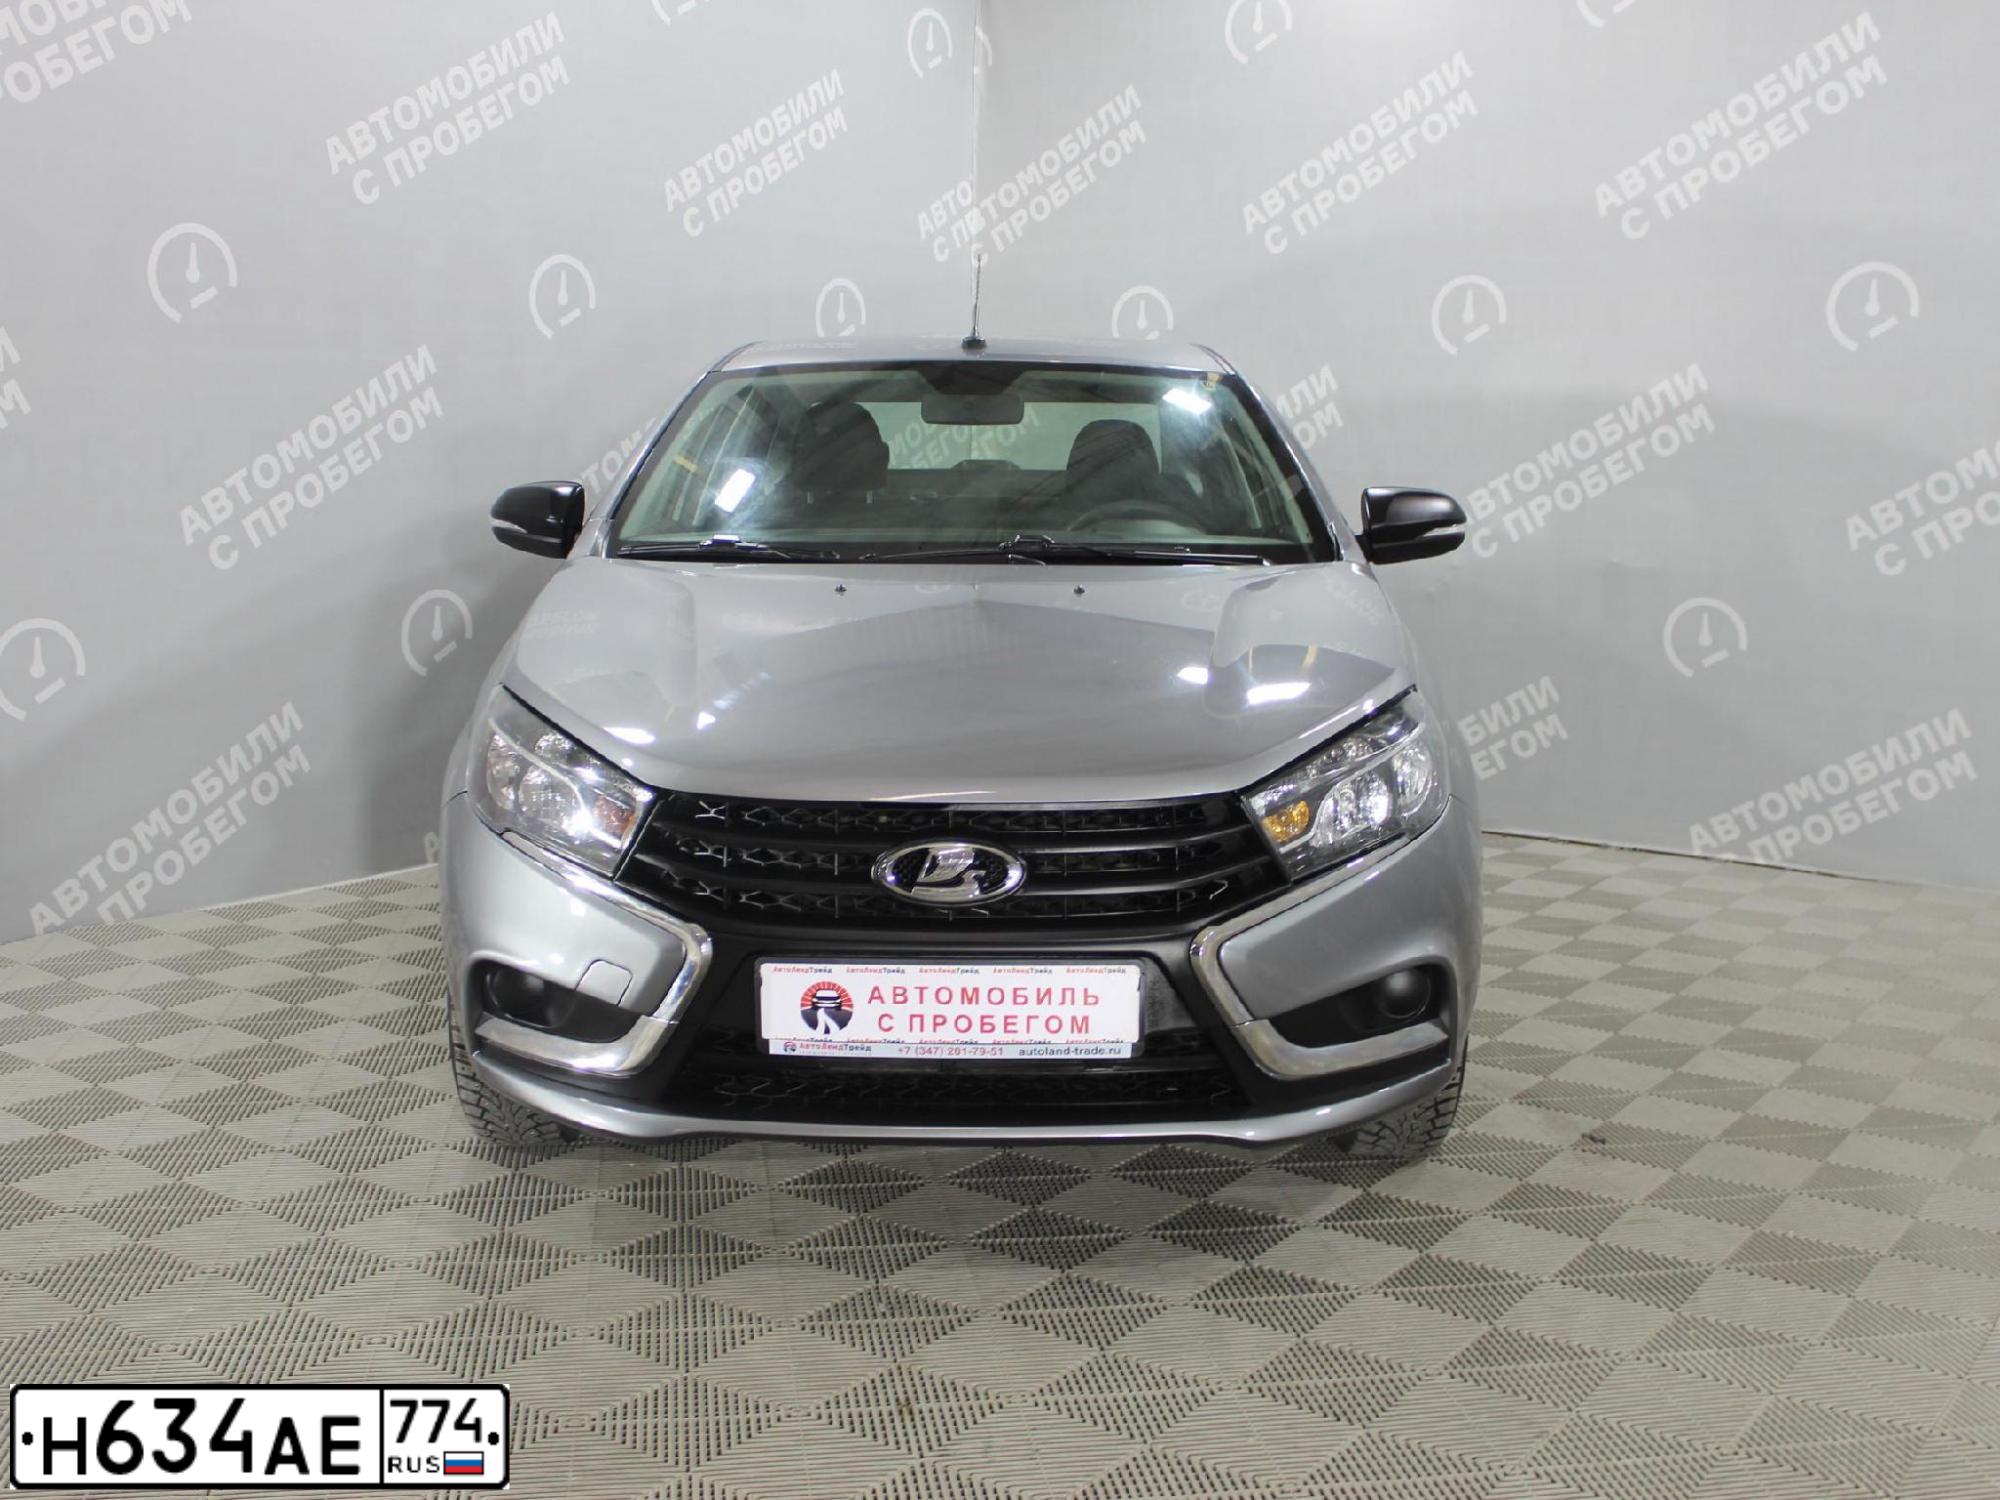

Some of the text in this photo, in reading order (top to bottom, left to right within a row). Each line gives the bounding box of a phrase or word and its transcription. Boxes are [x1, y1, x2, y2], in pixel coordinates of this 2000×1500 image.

[0, 0, 193, 103] ОБЕГОМ
[325, 12, 566, 175] АВТОМОБИЛИ
[1595, 11, 1880, 218] АВТОМОБИЛИ
[352, 57, 571, 205] С ПРОБЕГОМ
[663, 69, 845, 212] АВТОМОБИЛИ
[683, 106, 848, 238] С ПРОБЕГОМ
[990, 121, 1147, 252] ПРОБЕГОМ
[1242, 51, 1474, 234] АВТОМОБИЛИ
[1264, 90, 1479, 255] С ПРОБЕГОМ
[1620, 56, 1888, 241] С ПРОБЕГОМ
[918, 180, 972, 240] АВТО
[933, 235, 950, 262] С
[180, 345, 437, 545] АВТОМОБИЛИ
[208, 388, 443, 571] С ПРОБЕГОМ
[1467, 362, 1709, 525] ВТОМОБИЛИ
[1471, 403, 1715, 558] С ПРОБЕГОМ
[1845, 439, 2000, 552] АВТОМ
[1874, 543, 1907, 576] С
[29, 701, 304, 936] АВТОМОБИЛИ
[96, 744, 311, 924] ПРОБЕГОМ
[1688, 706, 1972, 850] АВТОМОБИЛИ
[1746, 750, 1979, 862] ПРОБЕГОМ
[868, 985, 1100, 1006] АВТОМОБИЛЬ
[878, 1013, 1090, 1035] С ПРОБЕГОМ
[898, 1046, 911, 1055] +7
[915, 1046, 943, 1056] (347)
[1019, 1047, 1121, 1057] autoland-trade.ru
